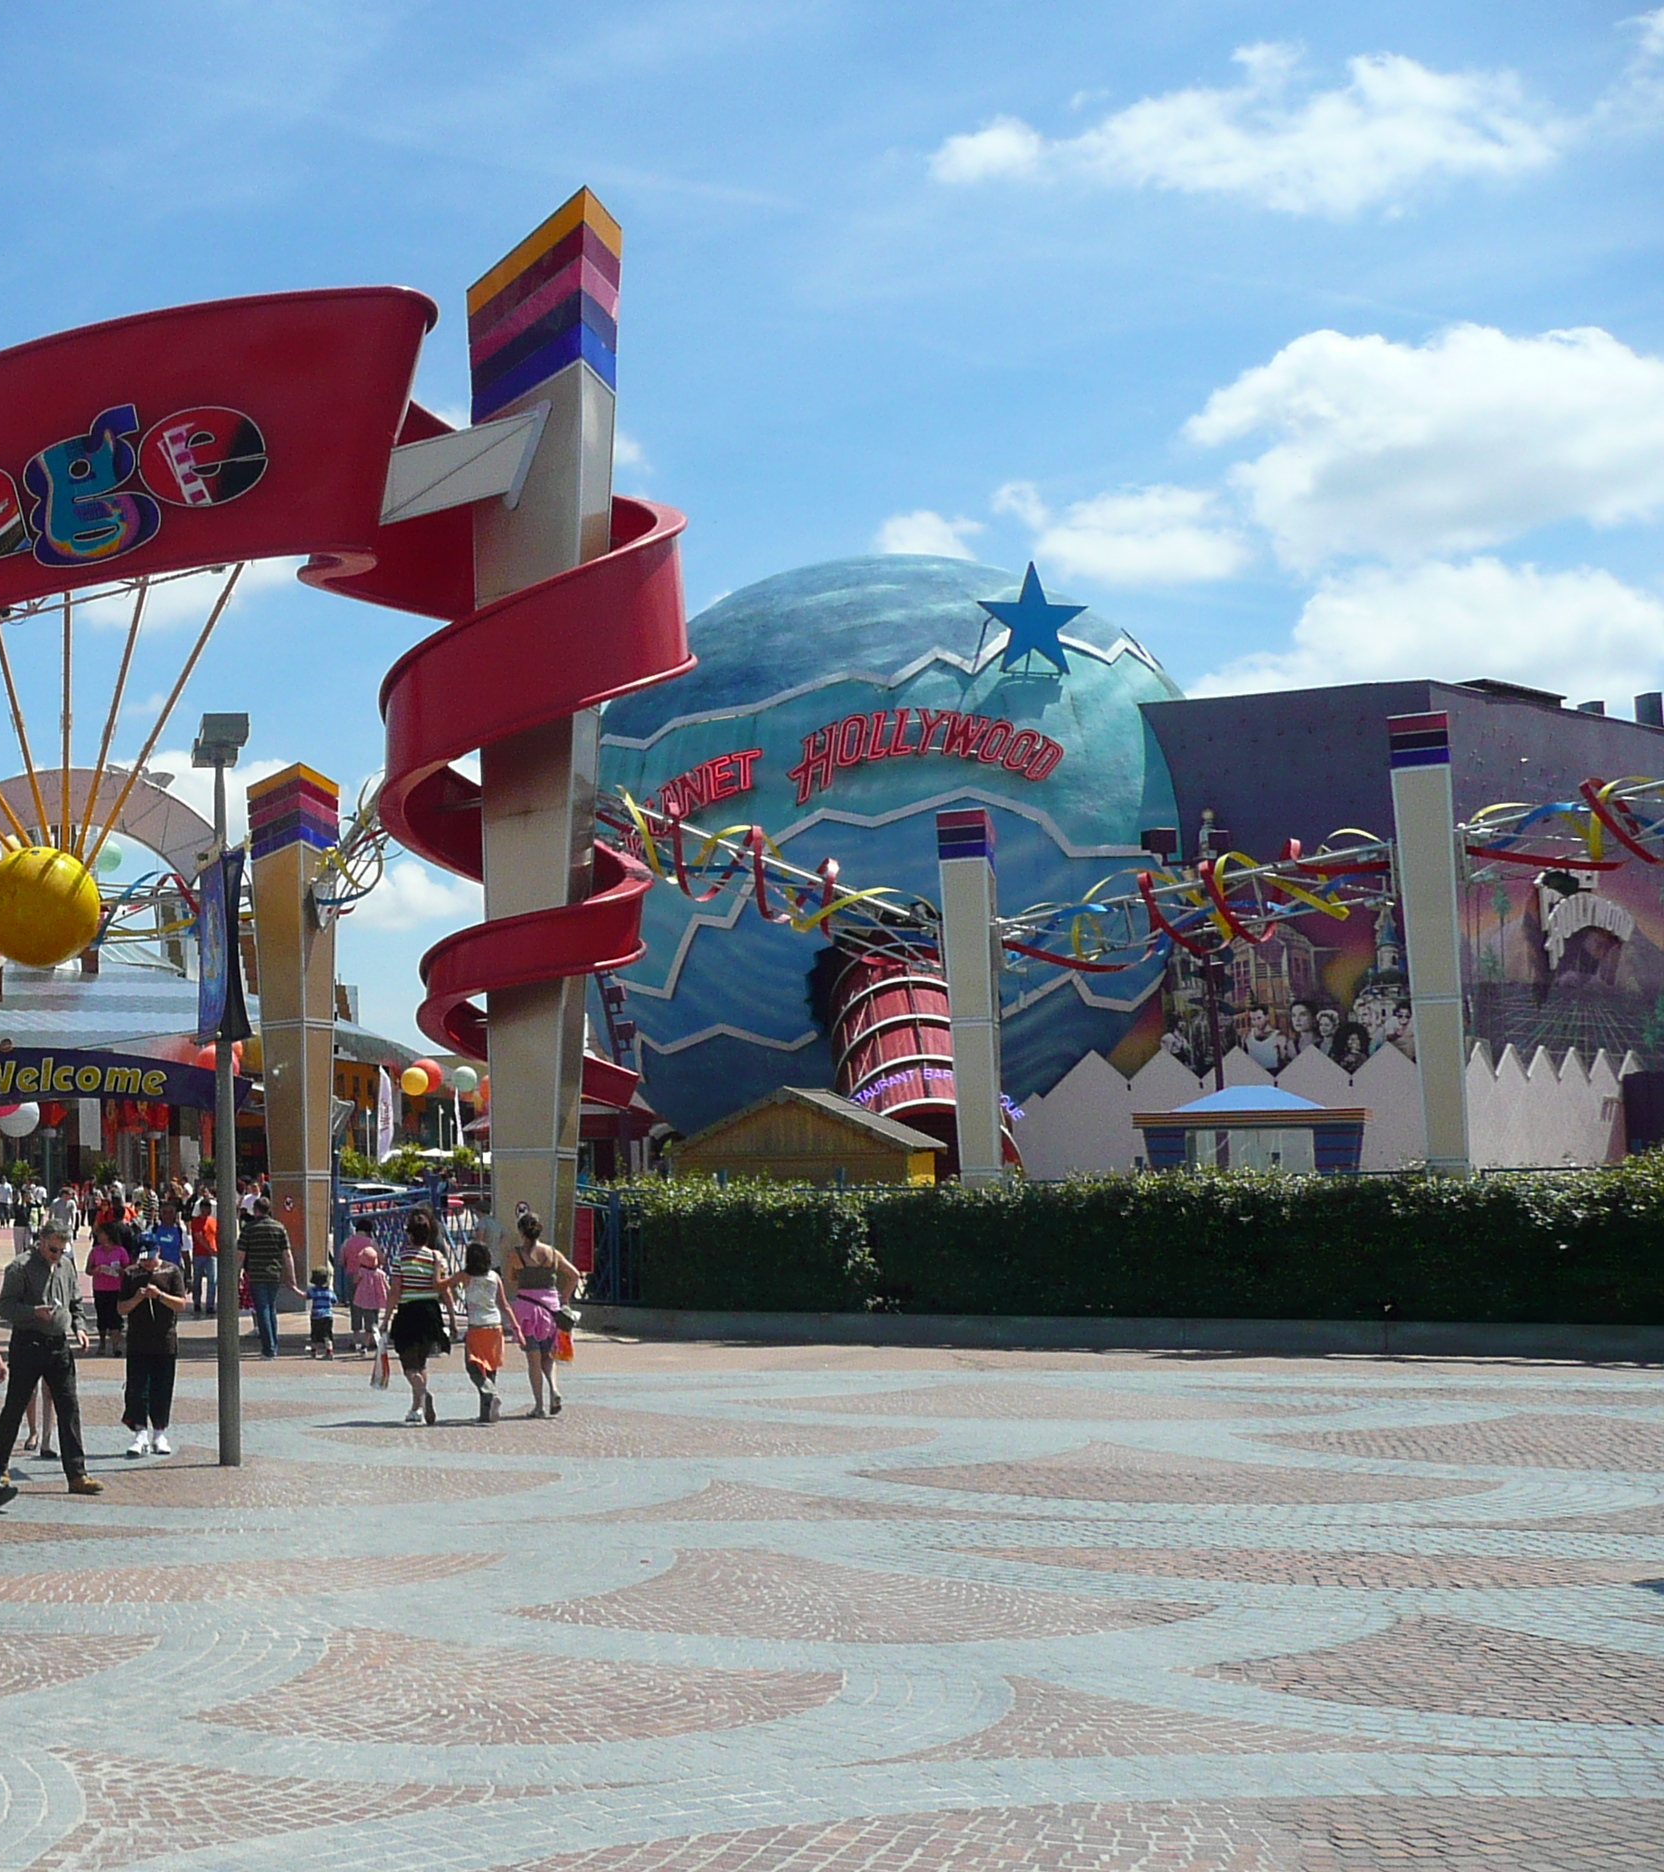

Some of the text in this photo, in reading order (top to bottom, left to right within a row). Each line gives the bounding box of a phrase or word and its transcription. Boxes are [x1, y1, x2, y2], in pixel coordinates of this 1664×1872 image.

[787, 708, 1065, 806] HOLLYWOOD
[922, 1068, 954, 1081] BAR
[999, 1091, 1026, 1122] QUE
